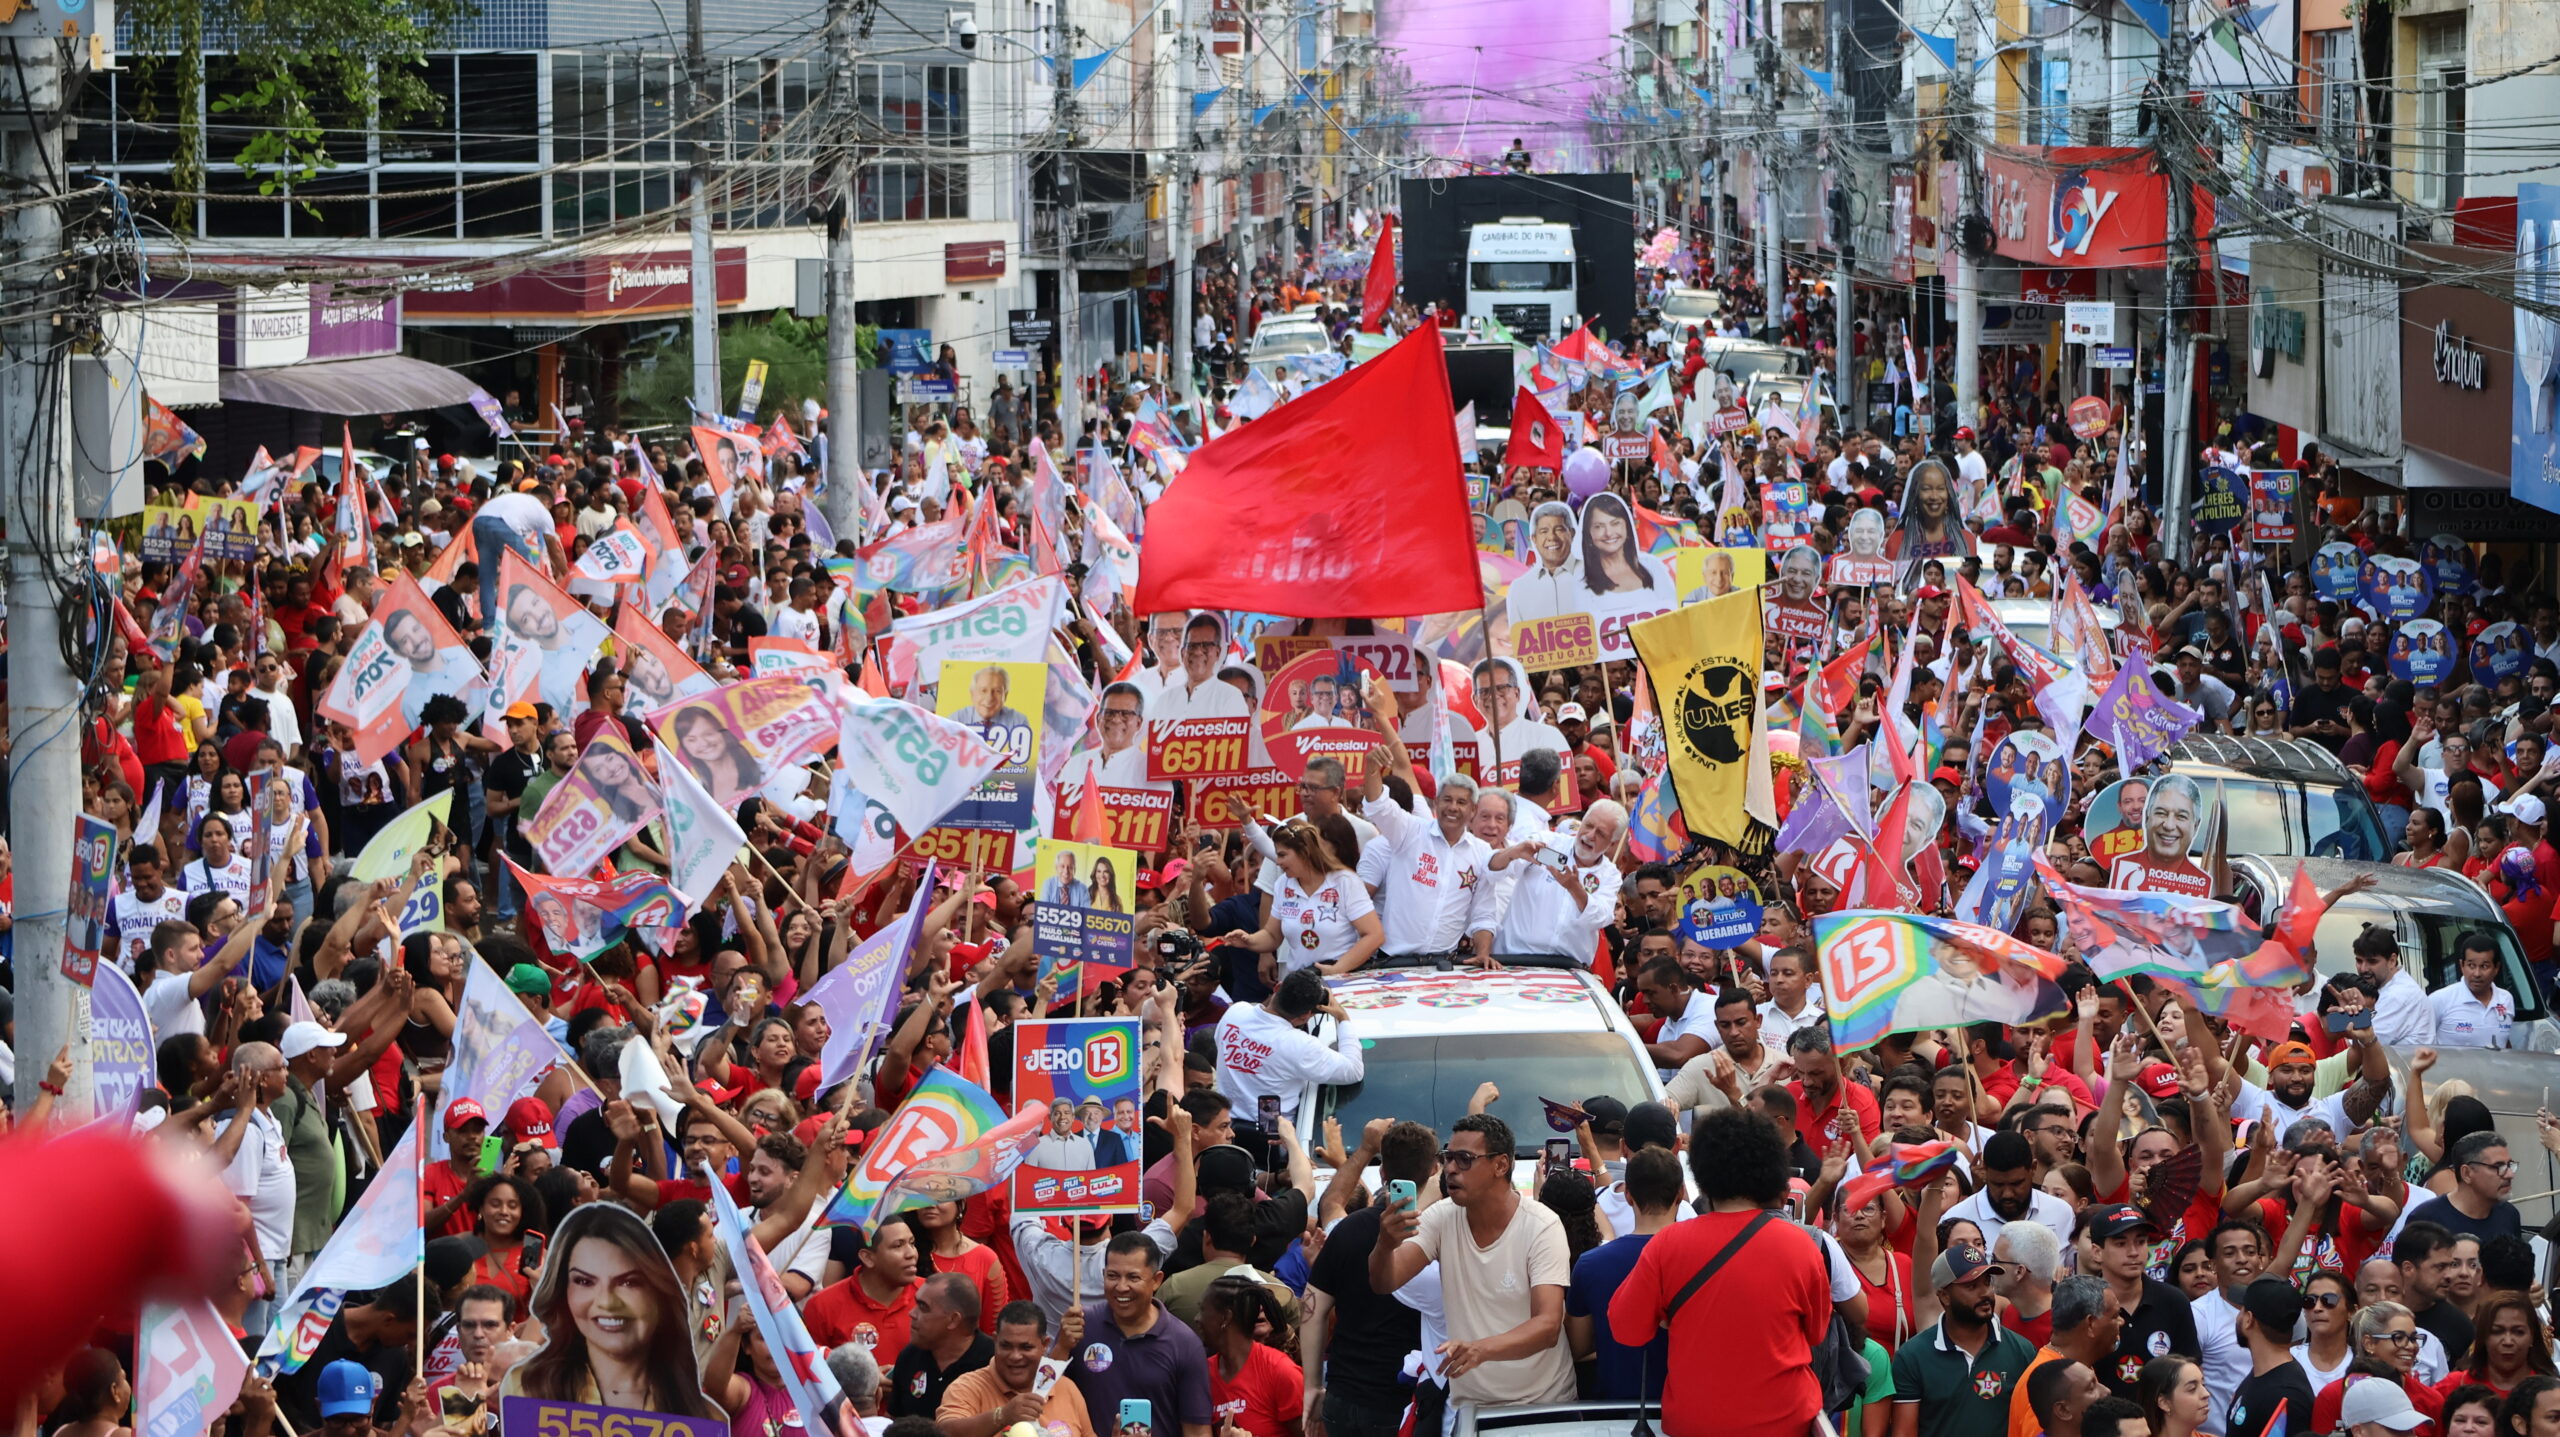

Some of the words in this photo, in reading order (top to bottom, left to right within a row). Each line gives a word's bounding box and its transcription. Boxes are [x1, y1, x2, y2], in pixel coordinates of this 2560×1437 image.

[622, 267, 645, 288] Banco
[646, 266, 654, 286] do
[655, 265, 689, 286] Nordeste
[2025, 288, 2049, 303] Boa
[321, 306, 341, 327] Aqui
[342, 306, 358, 322] tem
[2013, 305, 2046, 321] CDL
[251, 315, 304, 338] NORDESTE
[2447, 336, 2482, 389] natura
[1469, 483, 1480, 496] 13
[1764, 491, 1787, 502] JERO
[1788, 487, 1800, 501] 13
[2254, 480, 2276, 490] JERO
[2278, 478, 2291, 492] 13
[2423, 492, 2445, 510] O
[2204, 504, 2242, 519] POLÍTICA
[226, 535, 254, 545] 55670
[590, 540, 620, 571] 7070
[1782, 607, 1824, 620] ROSEMBERG
[1781, 617, 1822, 636] 13444
[1517, 620, 1593, 656] Alice
[1341, 644, 1412, 680] 522
[1517, 648, 1594, 664] PORTUGAL
[1673, 684, 1687, 744] MUNICIPAL
[1685, 696, 1753, 730] UMES
[1152, 717, 1249, 744] Wenceslau
[1296, 736, 1368, 753] Wenceslau
[1162, 737, 1243, 773] 65111
[1684, 745, 1717, 772] UNIÃO
[1057, 780, 1170, 812] Wnceslau
[94, 841, 106, 870] 13
[1419, 852, 1437, 865] JERO
[1957, 855, 1975, 866] ULA
[1423, 862, 1439, 875] LULA
[2148, 868, 2207, 887] ROSEMBERG
[1411, 873, 1438, 888] WAGNER
[635, 904, 668, 926] 13
[1036, 906, 1083, 928] 5529
[1086, 914, 1131, 934] 55670
[1713, 910, 1747, 922] FUTURO
[1039, 926, 1063, 937] PAULO
[1039, 933, 1083, 945] MAGALHÃES
[1695, 922, 1755, 942] BUERAREMA
[1096, 940, 1118, 949] CASTRO
[1833, 925, 1892, 993] 13
[1222, 1023, 1240, 1043] Tô
[1241, 1038, 1272, 1057] com
[1025, 1046, 1083, 1071] JERO
[1090, 1043, 1119, 1074] 13
[1224, 1043, 1262, 1070] Jero
[526, 1120, 551, 1135] LULA
[873, 1110, 950, 1182] 13
[1033, 1178, 1056, 1189] WAGNER
[1063, 1179, 1079, 1189] RUI
[1090, 1180, 1119, 1191] LULA
[1037, 1188, 1054, 1198] 130
[1069, 1188, 1085, 1197] 133
[2125, 1363, 2136, 1375] 13
[1983, 1380, 1992, 1390] 13
[537, 1404, 696, 1437] 55670
